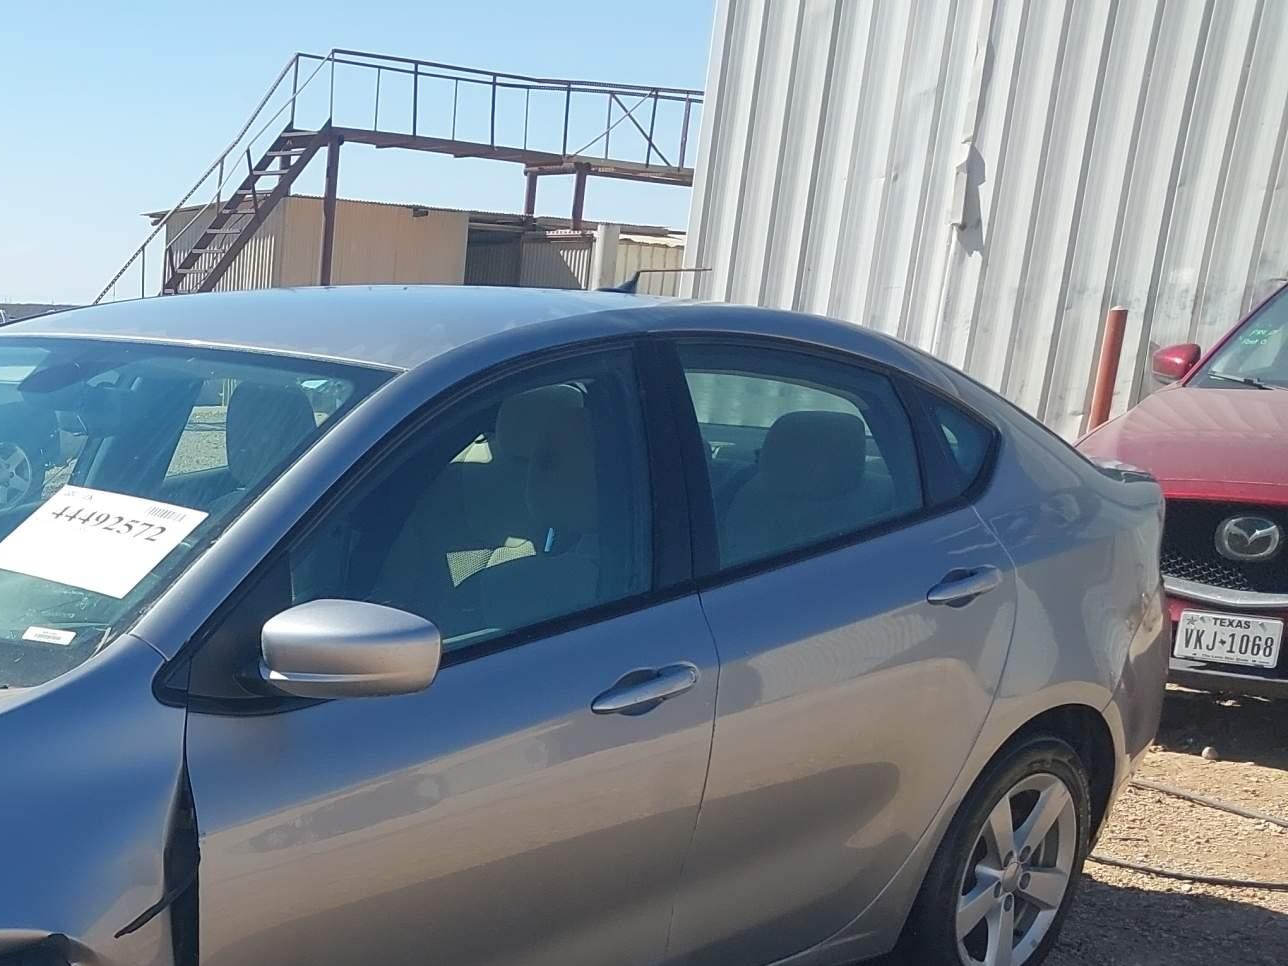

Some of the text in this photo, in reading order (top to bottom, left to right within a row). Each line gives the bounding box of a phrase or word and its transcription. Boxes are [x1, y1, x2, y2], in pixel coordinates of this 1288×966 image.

[52, 505, 167, 542] 44492572
[1212, 617, 1251, 629] TEXAS
[1184, 628, 1274, 657] VKJ 1068
